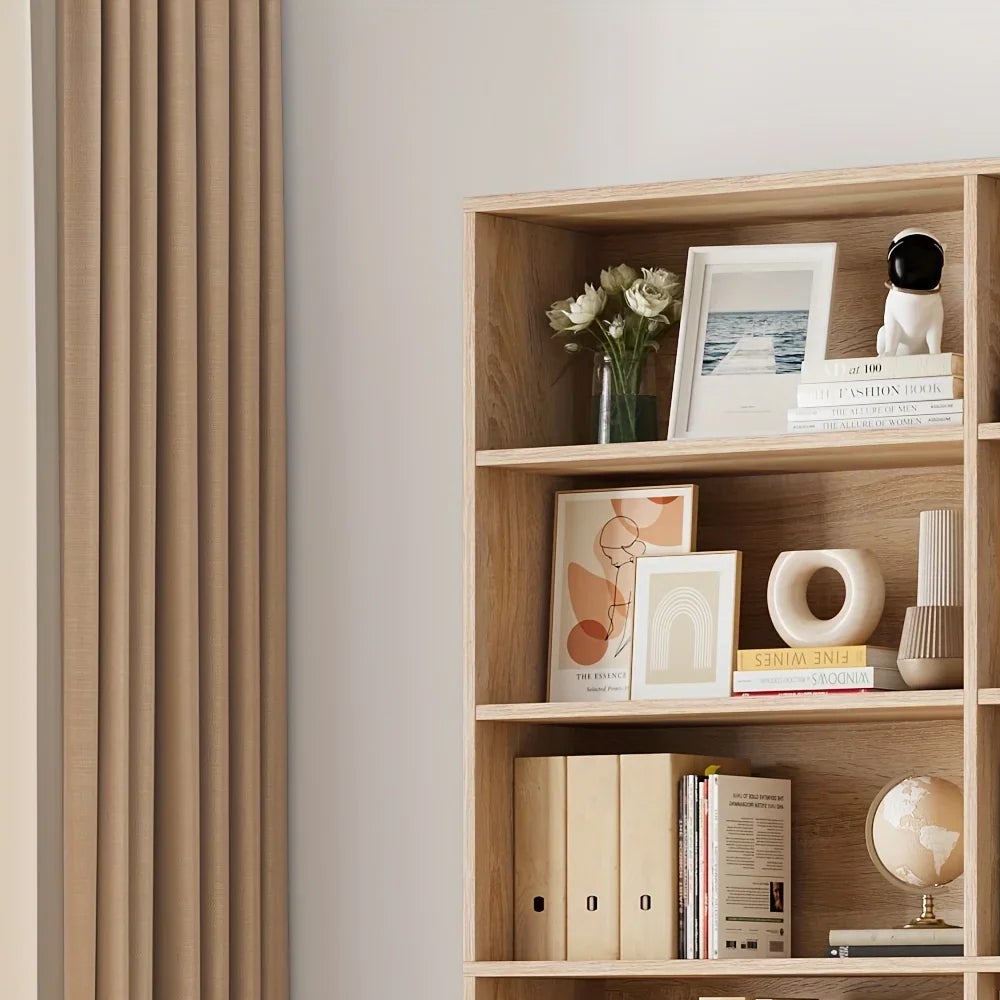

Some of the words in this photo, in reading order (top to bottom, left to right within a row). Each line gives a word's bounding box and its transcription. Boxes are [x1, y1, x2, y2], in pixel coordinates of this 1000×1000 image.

[865, 364, 882, 373] 100
[839, 385, 900, 398] FASHION
[905, 384, 941, 394] BOOK
[840, 421, 872, 429] ALLURE
[889, 418, 922, 426] WOMEN
[755, 652, 806, 666] WINES
[814, 650, 848, 665] FINE
[811, 671, 870, 686] WINDOWS
